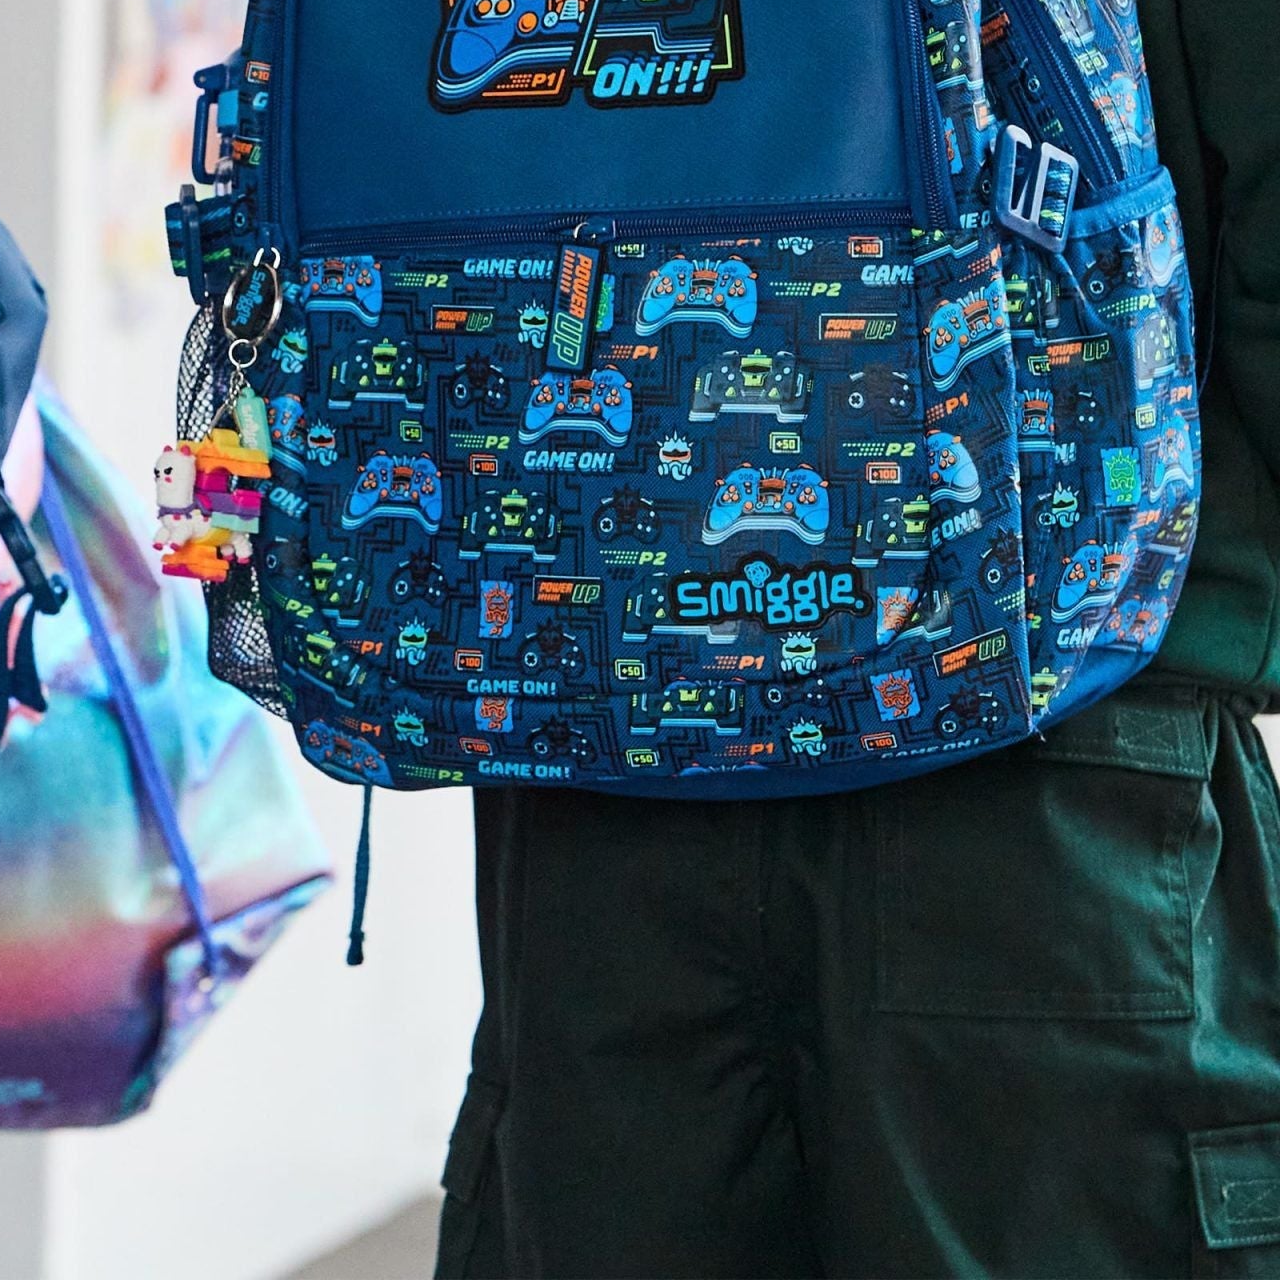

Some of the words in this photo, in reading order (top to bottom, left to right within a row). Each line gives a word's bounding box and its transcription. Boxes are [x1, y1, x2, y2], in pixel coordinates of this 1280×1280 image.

[531, 73, 556, 87] P1
[592, 59, 711, 98] ON!!!
[619, 244, 641, 255] +50
[854, 243, 880, 255] +100
[463, 259, 516, 278] GAME
[518, 259, 553, 279] ON!
[424, 275, 448, 288] P2
[568, 252, 593, 320] POWER
[812, 282, 841, 297] P2
[435, 310, 468, 322] POWER
[467, 312, 493, 331] UP
[827, 319, 866, 331] POWER
[865, 320, 897, 340] UP
[551, 312, 583, 366] UP
[632, 345, 658, 360] P1
[1082, 339, 1110, 362] UP
[946, 392, 969, 415] P1
[404, 427, 420, 438] +50
[485, 436, 510, 449] P2
[775, 438, 796, 450] +50
[885, 443, 916, 457] P2
[475, 461, 496, 472] +100
[523, 451, 576, 470] GAME
[578, 452, 615, 470] ON!
[871, 468, 897, 480] +100
[269, 486, 309, 518] ON!
[941, 508, 982, 539] ON!
[639, 551, 667, 566] P2
[538, 581, 573, 593] POWER
[572, 585, 601, 603] UP
[286, 599, 314, 618] P2
[489, 626, 503, 635] P1
[360, 641, 383, 656] P1
[942, 644, 977, 665] POWER
[978, 635, 1007, 661] UP
[459, 656, 480, 668] +100
[739, 656, 765, 670] P1
[622, 666, 640, 677] +50
[467, 679, 519, 694] GAME
[522, 681, 557, 695] ON!
[894, 707, 908, 716] P1
[360, 722, 381, 737] P1
[488, 722, 502, 731] P1
[467, 742, 489, 753] +100
[750, 743, 774, 754] P1
[868, 737, 893, 749] +100
[633, 754, 654, 764] +50
[438, 769, 464, 782] P2
[479, 762, 532, 777] GAME
[534, 764, 570, 779] ON!
